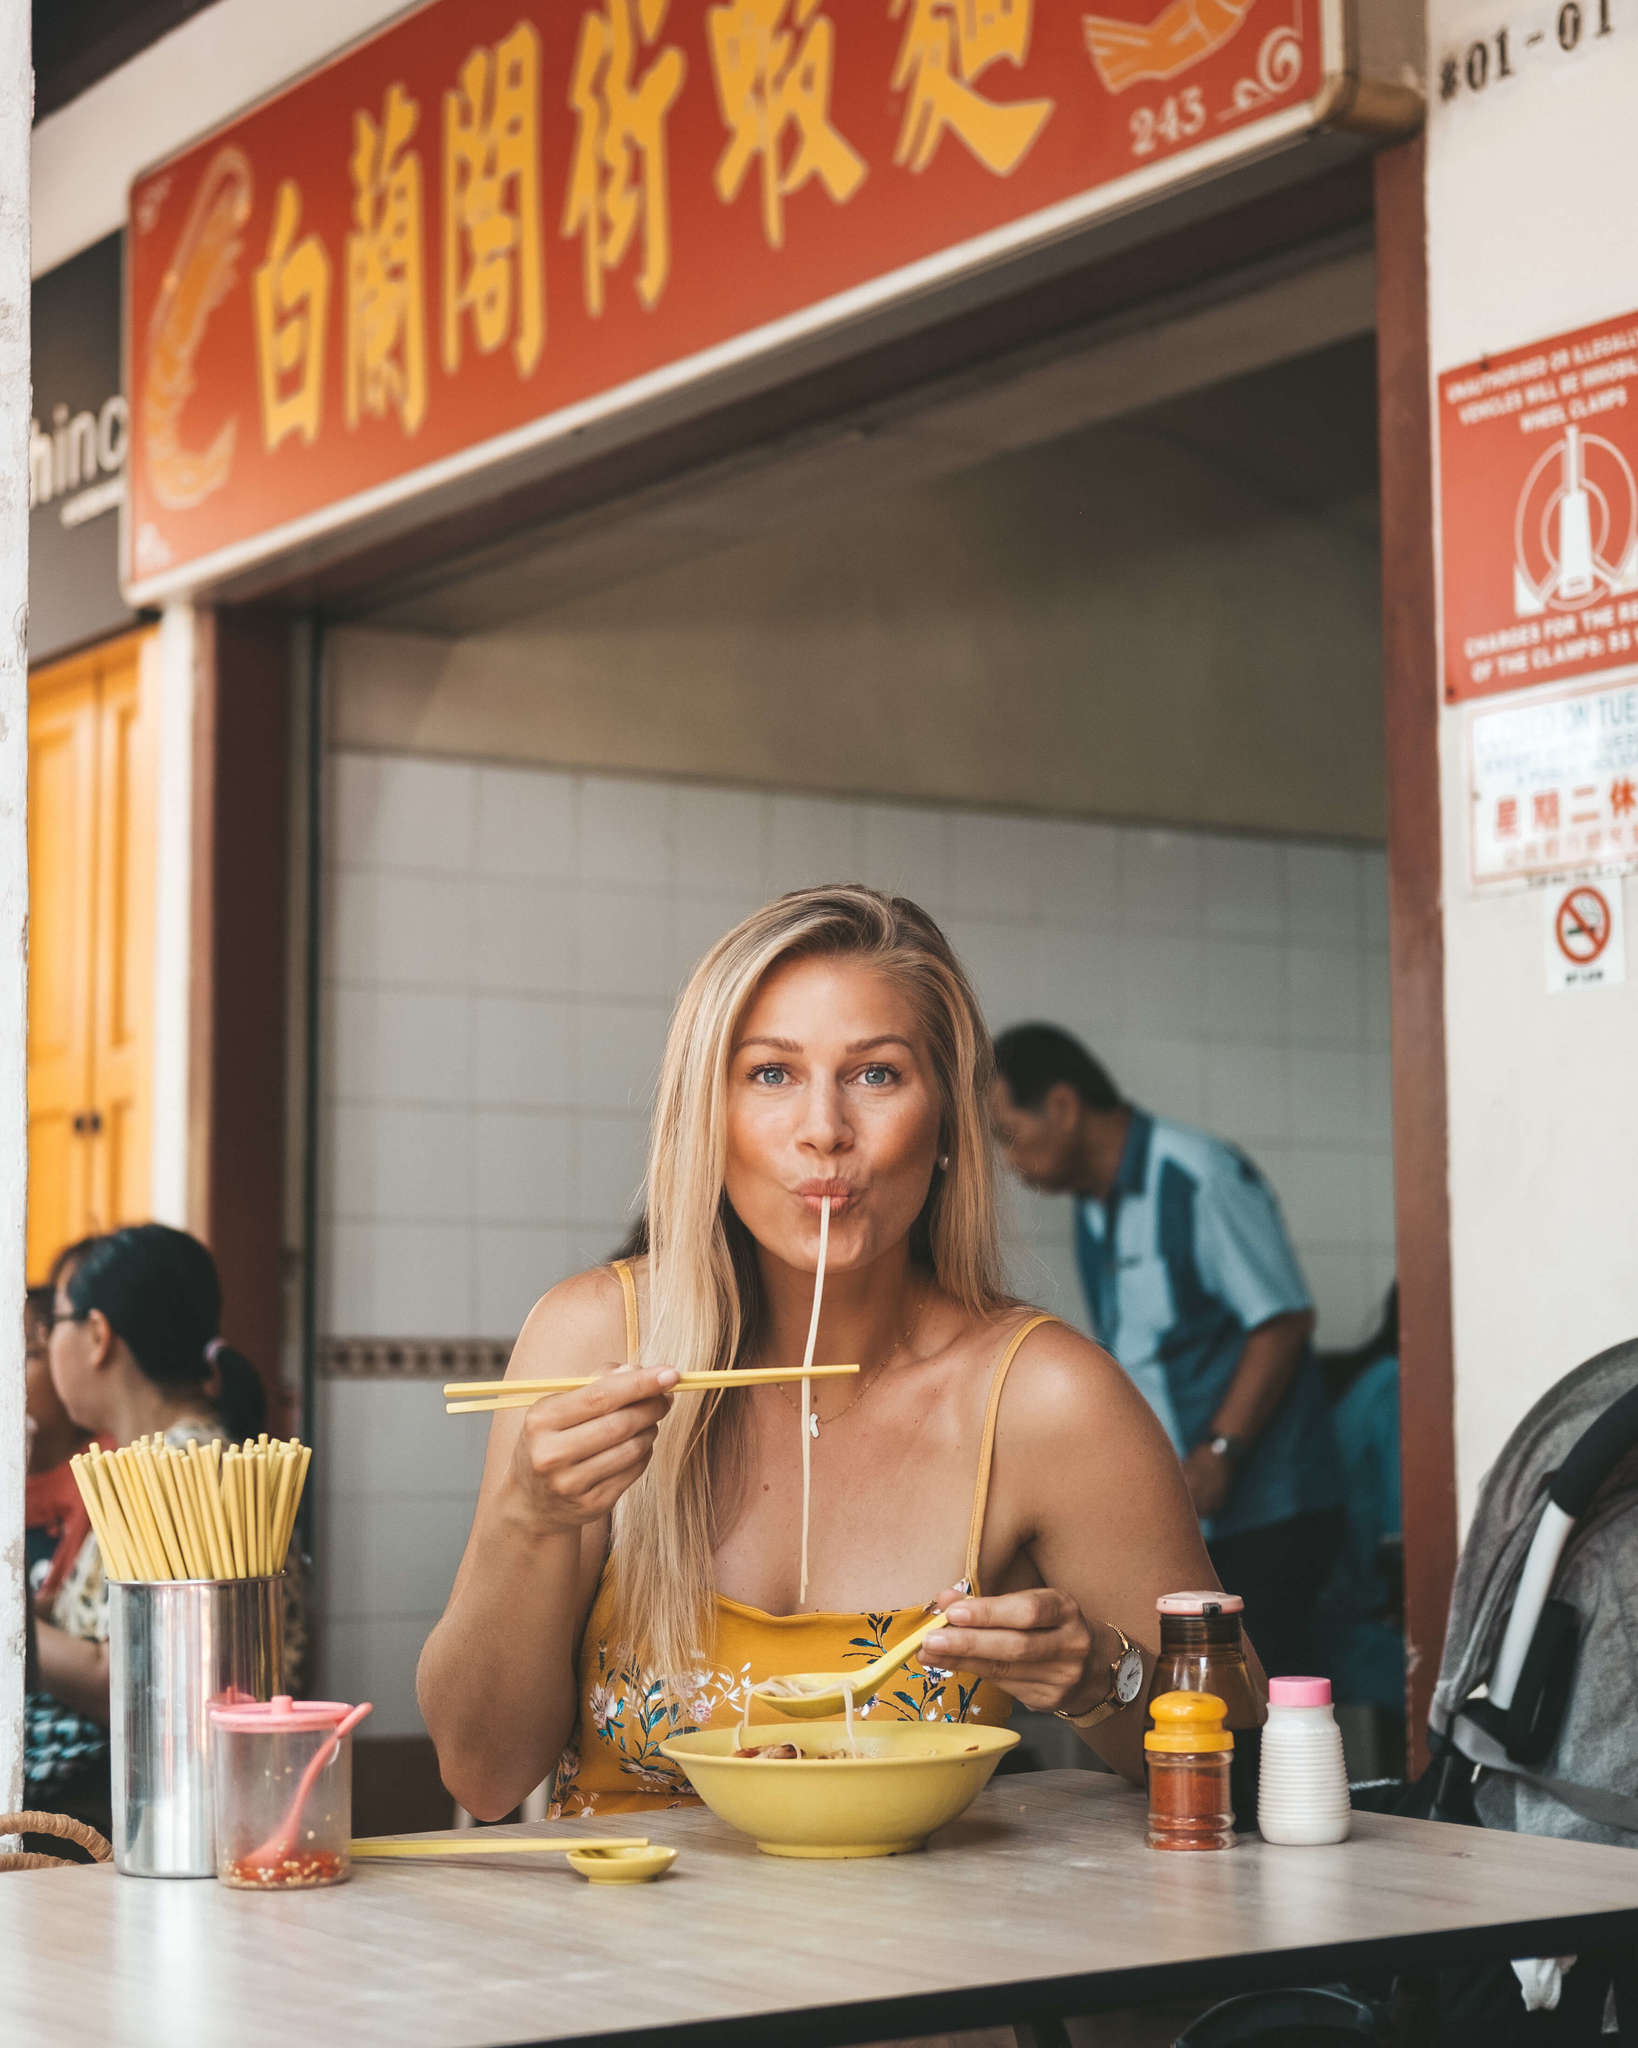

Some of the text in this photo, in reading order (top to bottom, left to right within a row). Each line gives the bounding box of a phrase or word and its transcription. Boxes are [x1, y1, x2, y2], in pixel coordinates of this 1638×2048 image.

[1550, 348, 1570, 372] OR
[1458, 390, 1523, 426] VEHICLES
[1525, 380, 1558, 405] WILL
[1560, 372, 1579, 395] BE
[1520, 386, 1628, 433] WHEEL CLAMPS
[1464, 622, 1541, 660] CHARGES
[1543, 614, 1577, 639] FOR
[1581, 604, 1615, 631] THE
[1471, 659, 1493, 684] OF
[1496, 651, 1529, 677] THE
